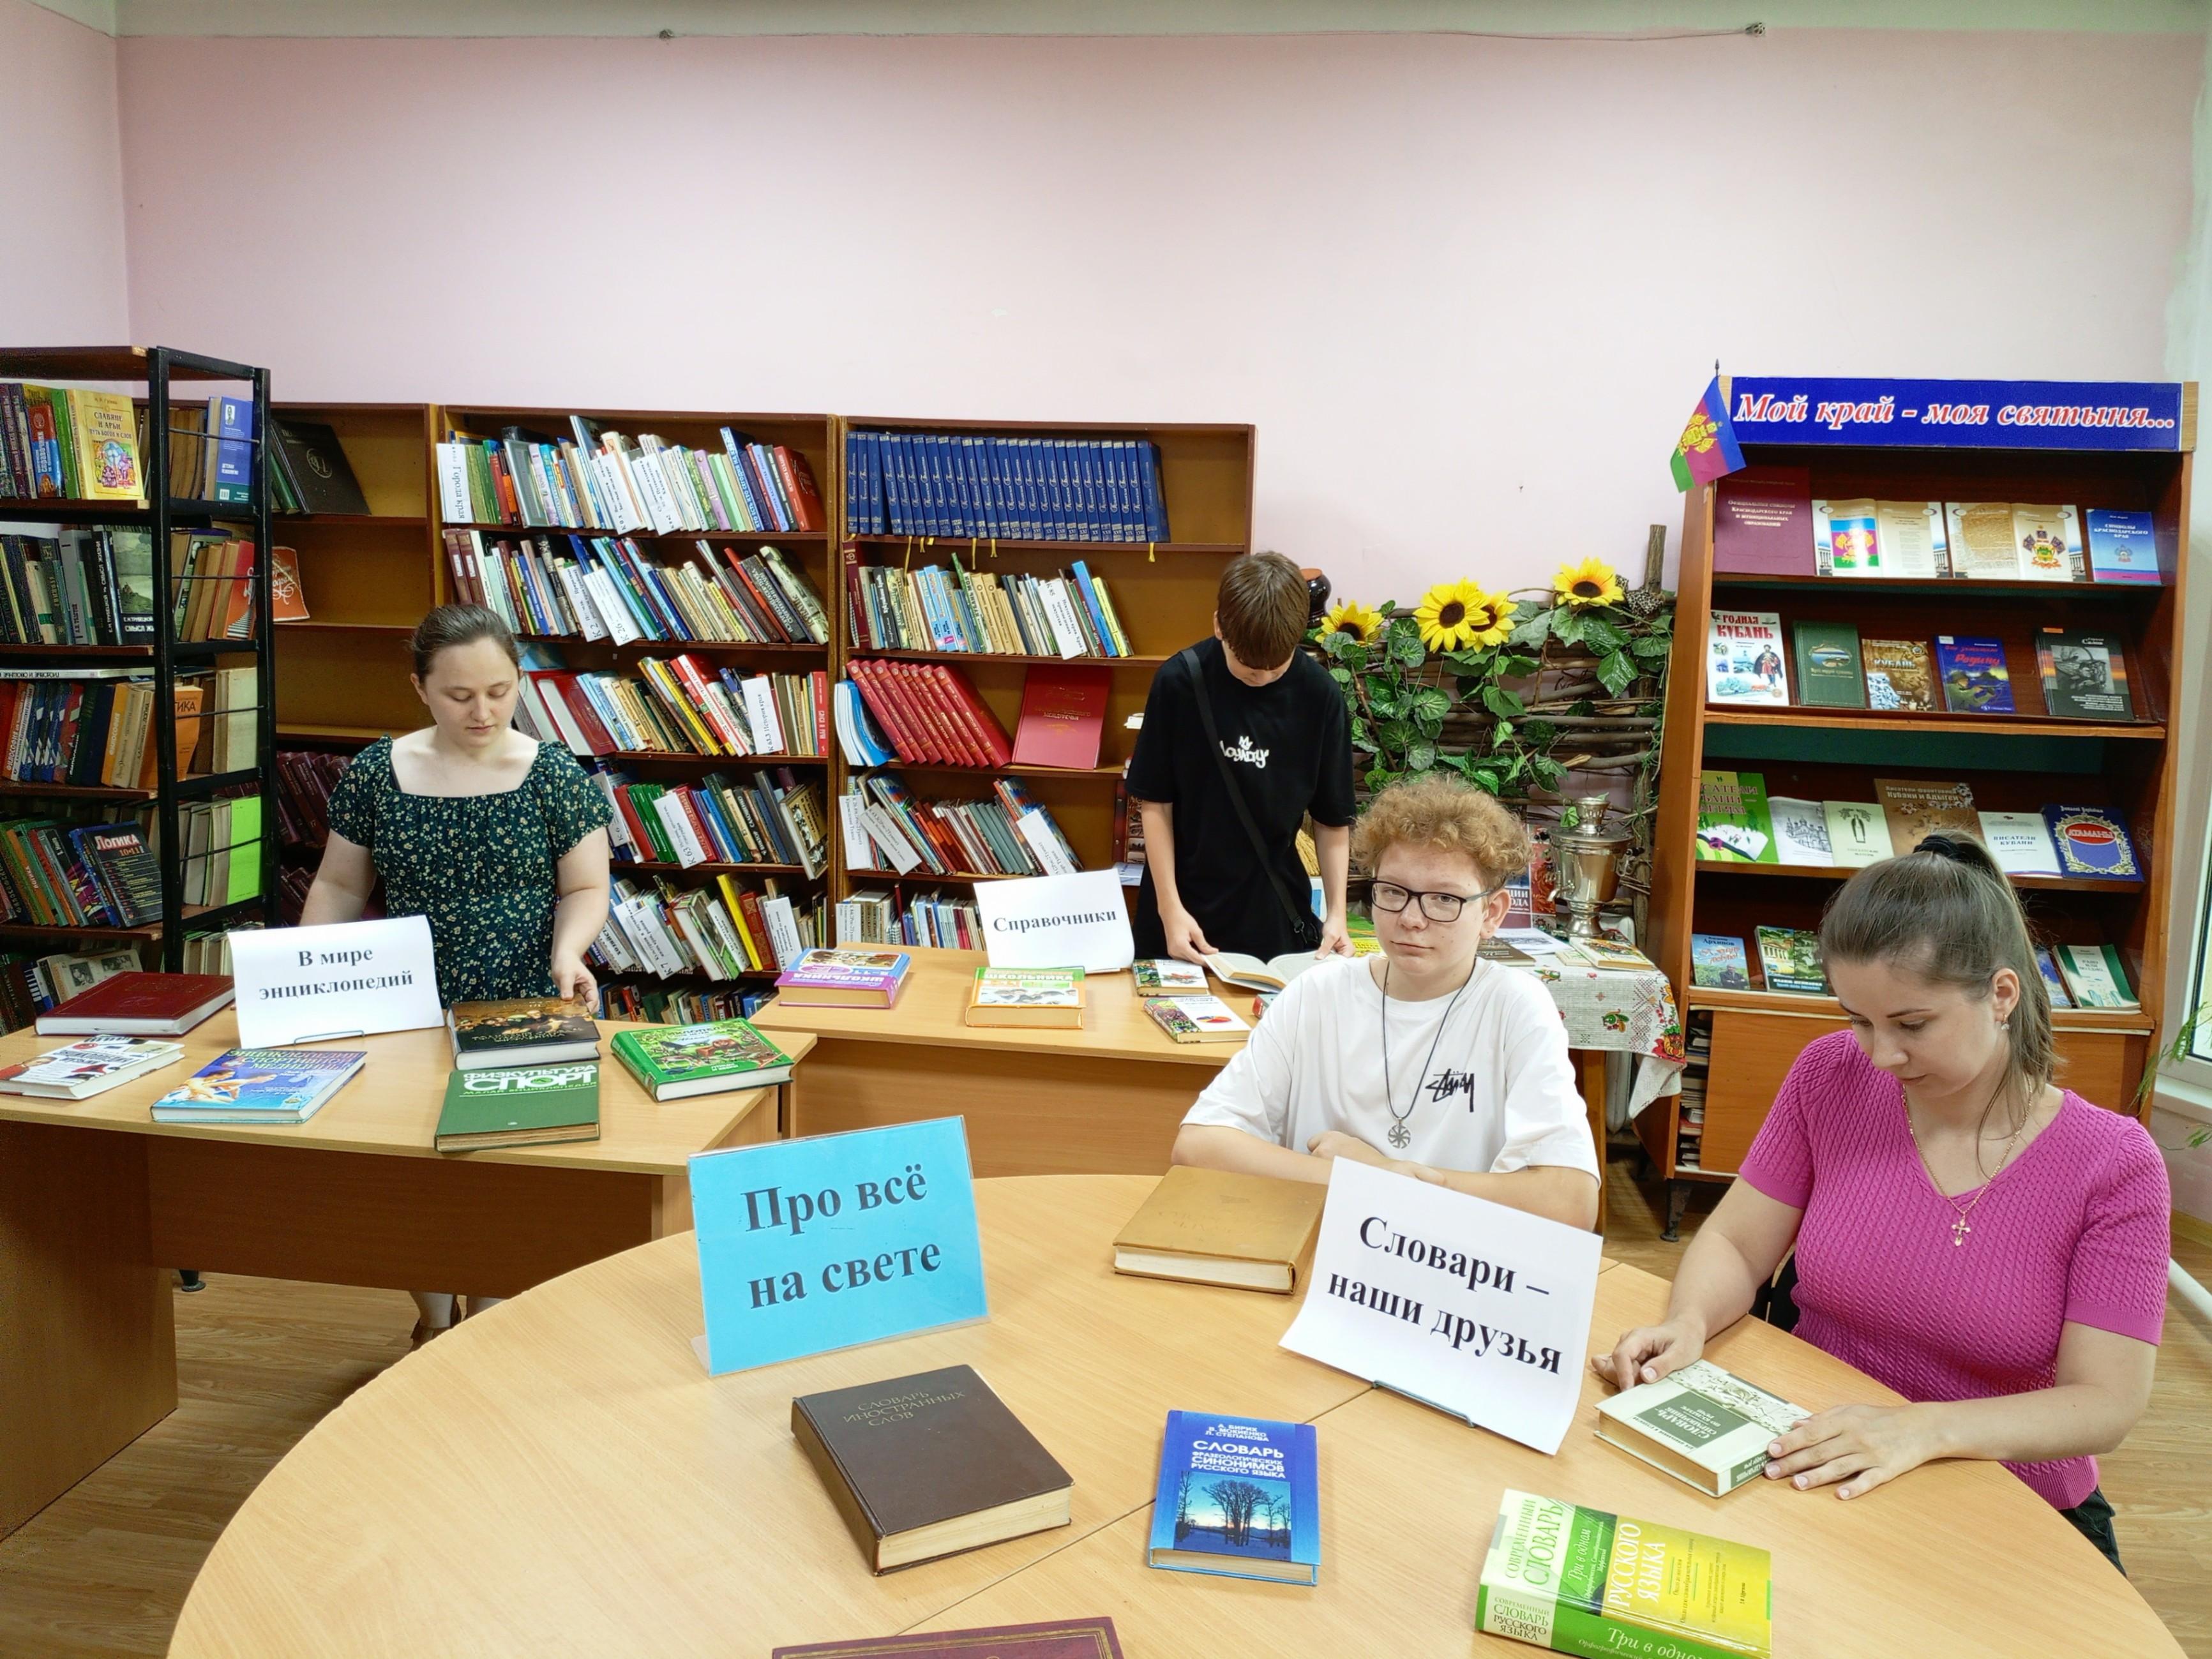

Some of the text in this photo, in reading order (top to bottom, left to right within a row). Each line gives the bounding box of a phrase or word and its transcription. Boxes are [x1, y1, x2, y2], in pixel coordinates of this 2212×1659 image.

[94, 412, 123, 422] СЛАВЯНЕ
[1734, 394, 1809, 422] Мой
[1816, 396, 1894, 430] край
[1922, 404, 1989, 425] моя
[1997, 405, 2176, 430] святыня...
[732, 456, 739, 464] НА
[735, 465, 747, 490] СЕГОДНЯ
[451, 466, 465, 519] Города края
[748, 502, 756, 515] ЕСТЬ
[963, 575, 980, 617] КУБАНЬ МОЯ
[1048, 589, 1055, 597] 85
[592, 629, 602, 638] К
[614, 622, 625, 634] 26
[1717, 625, 1773, 640] КУБАНЬ
[759, 707, 770, 732] История
[108, 712, 120, 755] ФИЛОСОФИЯ
[6, 731, 19, 770] ФИЛОСОФИЯ
[737, 795, 765, 850] ВИКТОР САЛОШЕНКО
[2068, 828, 2114, 839] АТАМАНЫ
[682, 846, 693, 857] 63
[24, 865, 39, 889] ЛОГИКА
[993, 911, 1116, 933] Справочники
[298, 949, 373, 967] В мире
[663, 967, 673, 975] К
[794, 973, 884, 982] ШКОЛЬНИКА
[259, 970, 413, 1000] энциклопедий
[463, 1064, 597, 1079] ФИЗКУЛЬТУРА
[464, 1070, 597, 1092] СПОРТ
[509, 1081, 597, 1092] ЭНЦИКЛОПЕДИЯ
[741, 1164, 927, 1236] Про всё
[1360, 1216, 1516, 1294] Словари
[748, 1243, 941, 1309] на свете
[1327, 1273, 1563, 1375] наши друзья
[843, 1391, 965, 1423] ИНОСТРАННЫХ
[858, 1390, 929, 1411] СЛОВАРЬ
[868, 1411, 914, 1427] СЛОВ
[1216, 1432, 1269, 1441] СТЕПАНОВА
[1219, 1428, 1266, 1437] МОКИЕНКО
[1192, 1452, 1283, 1465] ФРАЗЕОЛОГИЧЕСКИХ
[1193, 1440, 1284, 1459] СЛОВАРЬ
[1191, 1463, 1286, 1478] РУССКОГО ЯЗЫКА
[1192, 1456, 1284, 1472] СИНОНИМОВ
[1505, 1499, 1536, 1579] СОВРЕМЕННЫЙ
[1523, 1505, 1563, 1585] СЛОВАРЬ
[1568, 1528, 1591, 1581] Три в одном
[1608, 1523, 1641, 1607] РУССКОГО
[1637, 1542, 1666, 1603] ЯЗЫКА
[1494, 1604, 1548, 1626] СЛОВАРЬ
[1495, 1597, 1549, 1616] СОВРЕМЕННЫЙ
[1494, 1614, 1547, 1635] РУССКОГО
[1500, 1625, 1538, 1641] ЯЗЫКА
[1607, 1628, 1653, 1652] Три в
